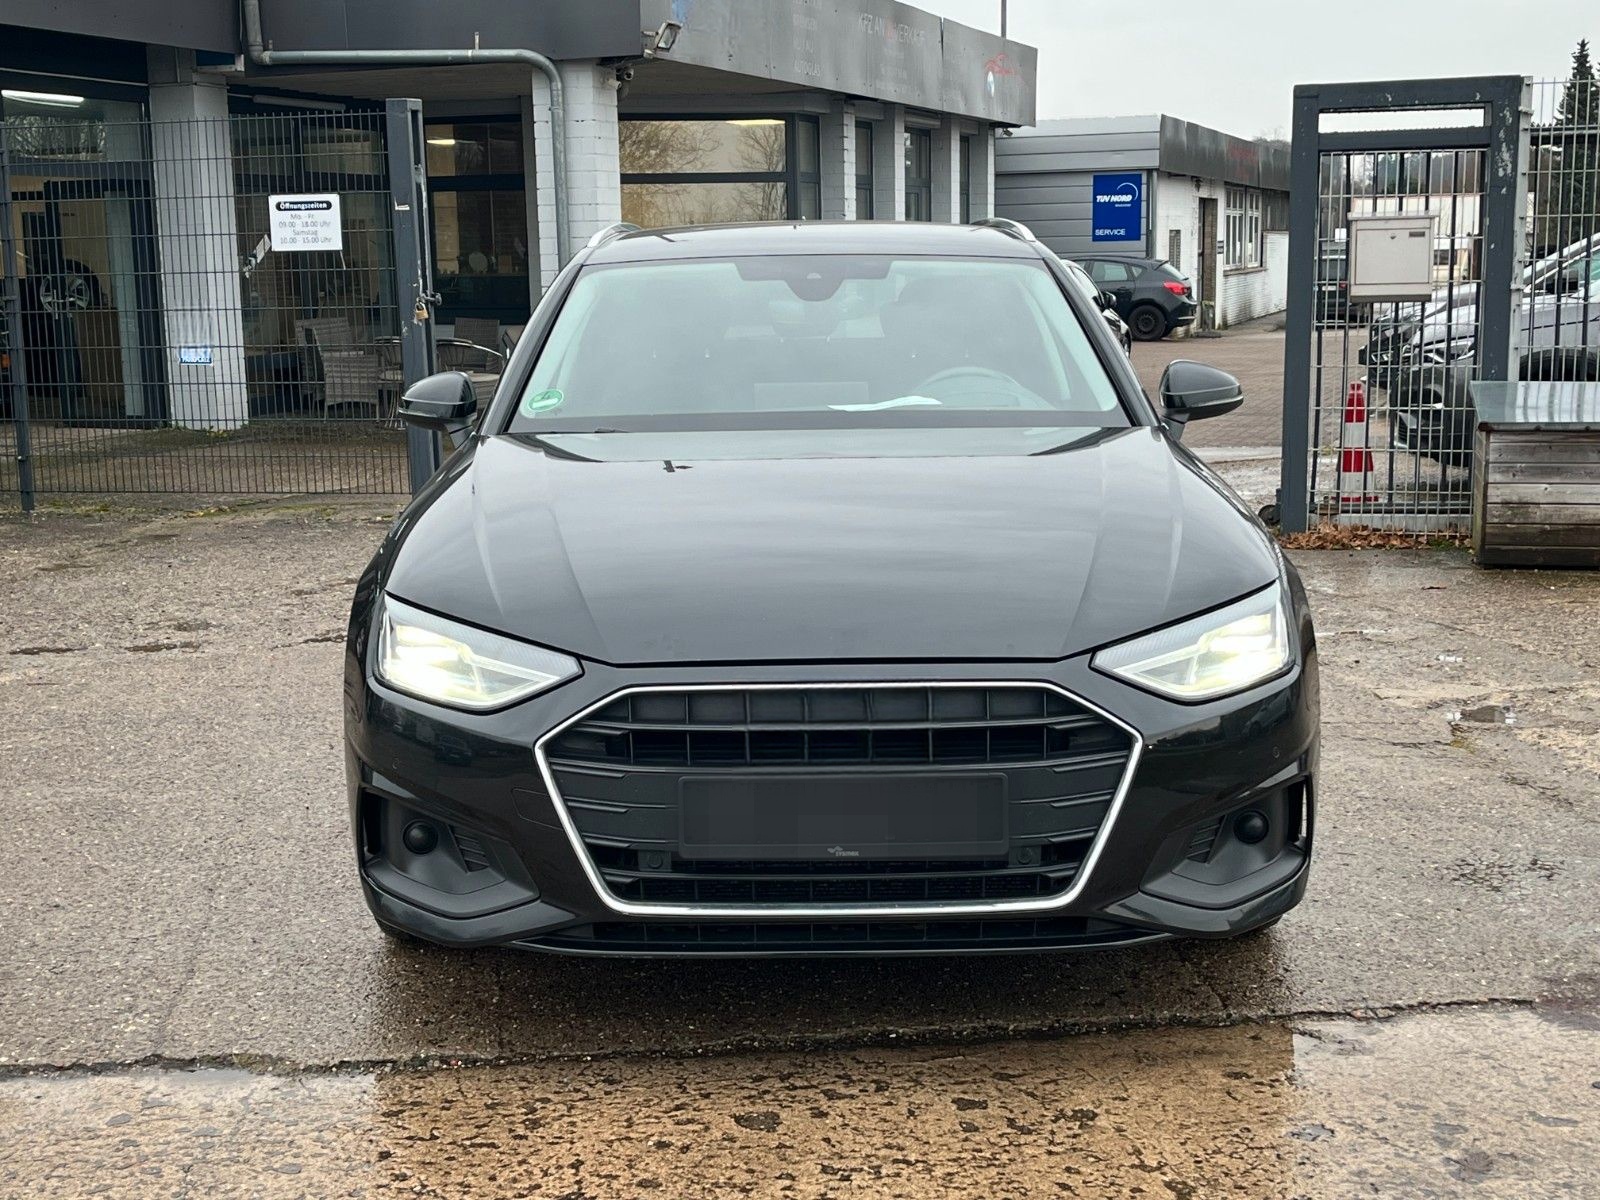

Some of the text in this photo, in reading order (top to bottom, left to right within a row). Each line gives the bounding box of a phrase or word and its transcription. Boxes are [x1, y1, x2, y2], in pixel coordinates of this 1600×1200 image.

[1110, 194, 1132, 202] NORD
[279, 202, 327, 210] Öffnungszeiten
[319, 220, 331, 228] Uhr
[320, 236, 332, 244] Uhr
